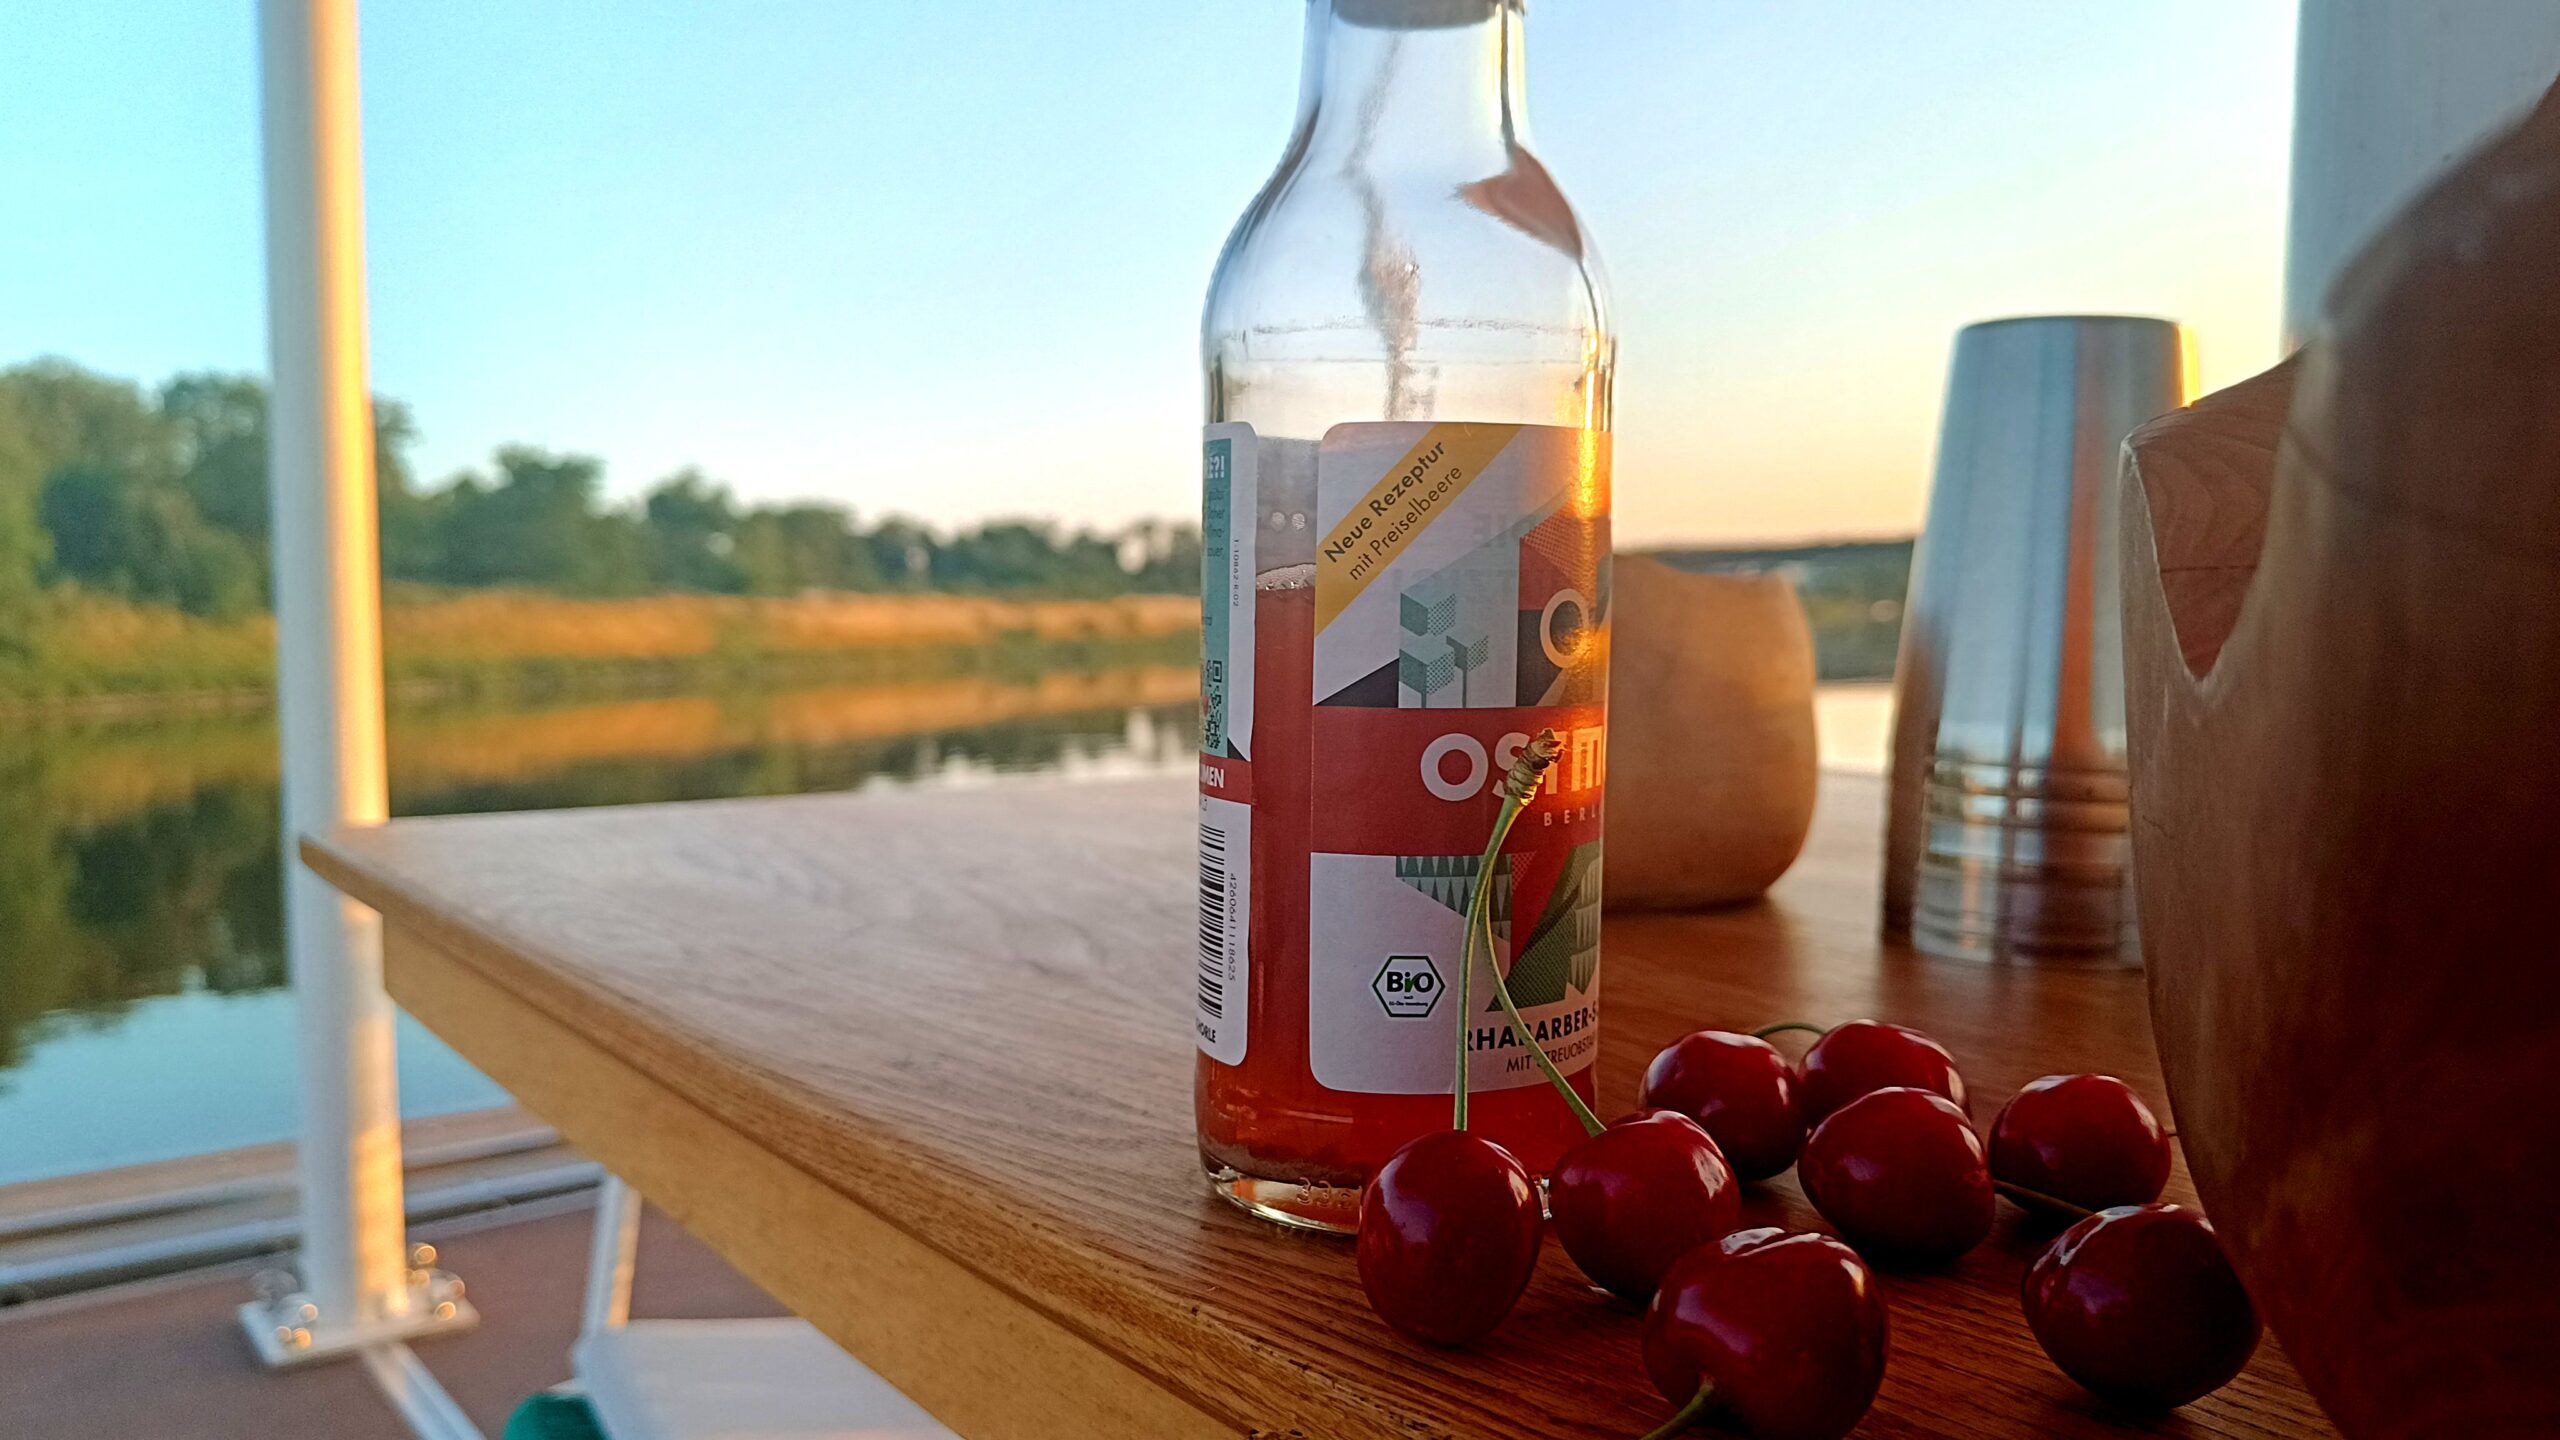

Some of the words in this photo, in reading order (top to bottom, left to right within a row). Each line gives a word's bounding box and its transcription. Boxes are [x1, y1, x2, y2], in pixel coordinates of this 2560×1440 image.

[1323, 517, 1373, 563] Neue
[1368, 441, 1446, 517] Rezeptur
[1349, 552, 1374, 581] mit
[1369, 466, 1463, 556] Preiselbeere
[1543, 804, 1602, 827] BERL
[1229, 872, 1237, 982] 4260641118625
[1506, 1055, 1532, 1073] MIT
